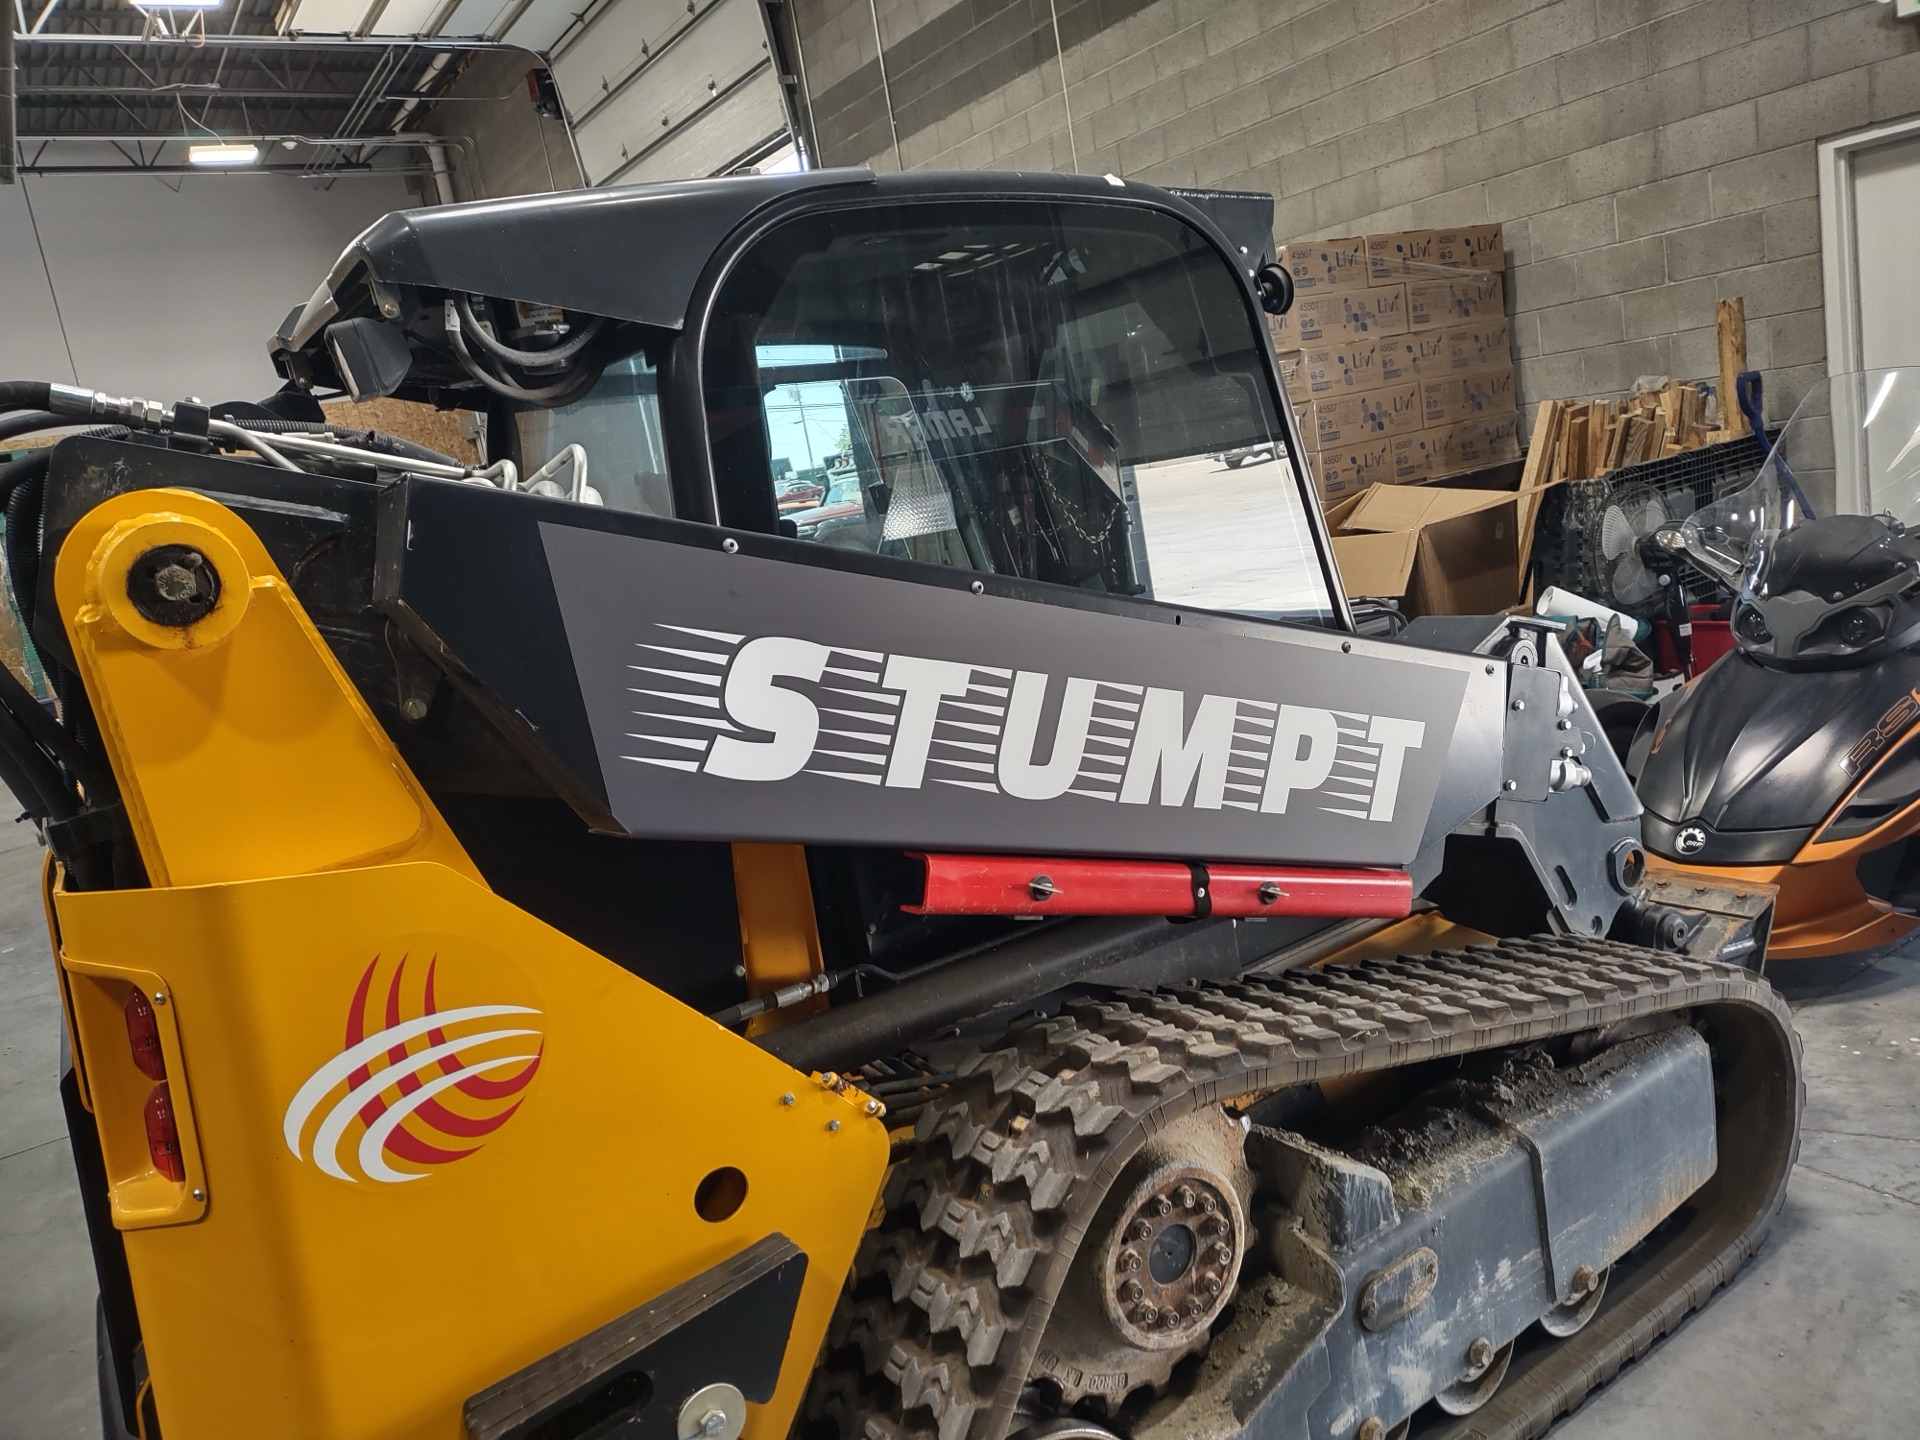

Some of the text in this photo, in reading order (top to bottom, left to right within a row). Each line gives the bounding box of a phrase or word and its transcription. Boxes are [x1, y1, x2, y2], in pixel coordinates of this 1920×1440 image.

[1439, 235, 1457, 244] 45507
[1370, 241, 1388, 250] 45507
[1292, 249, 1312, 259] 45507
[1299, 301, 1319, 311] 45507
[1380, 342, 1398, 352] 45507
[1424, 384, 1442, 393] 45507
[1318, 404, 1337, 414] 45507
[1324, 454, 1342, 465] 45507
[702, 636, 1426, 822] STUMPT
[1839, 687, 1920, 778] RS
